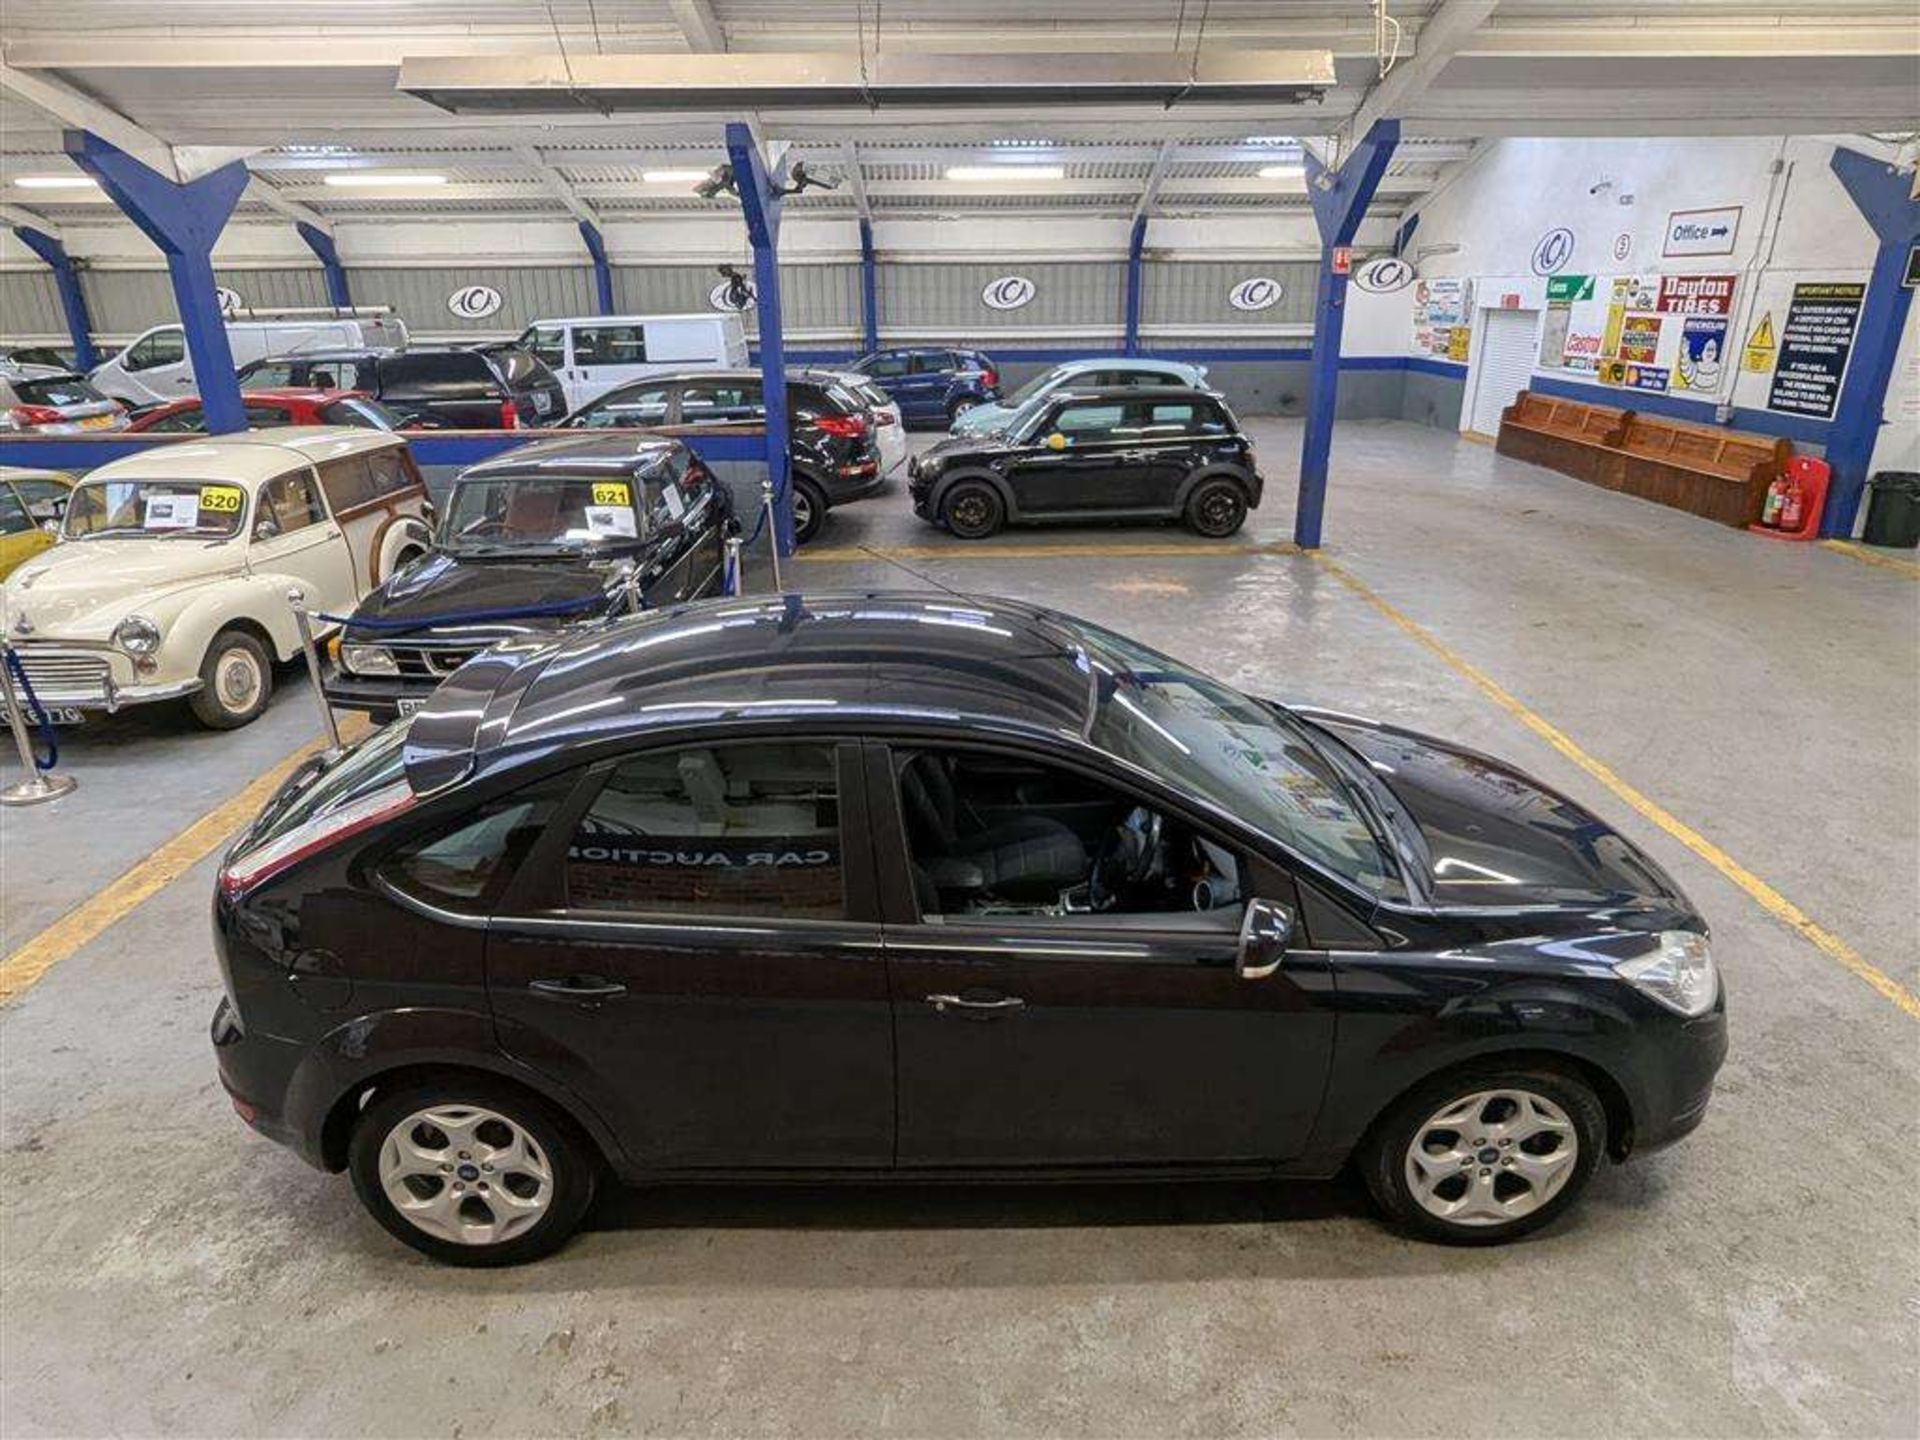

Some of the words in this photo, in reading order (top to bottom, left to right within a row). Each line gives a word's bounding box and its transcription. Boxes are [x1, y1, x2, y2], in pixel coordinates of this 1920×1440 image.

[1673, 225, 1709, 241] Office
[1664, 277, 1729, 299] Dayton
[1666, 299, 1720, 314] TIRES
[202, 494, 238, 509] 620
[595, 490, 626, 503] 621
